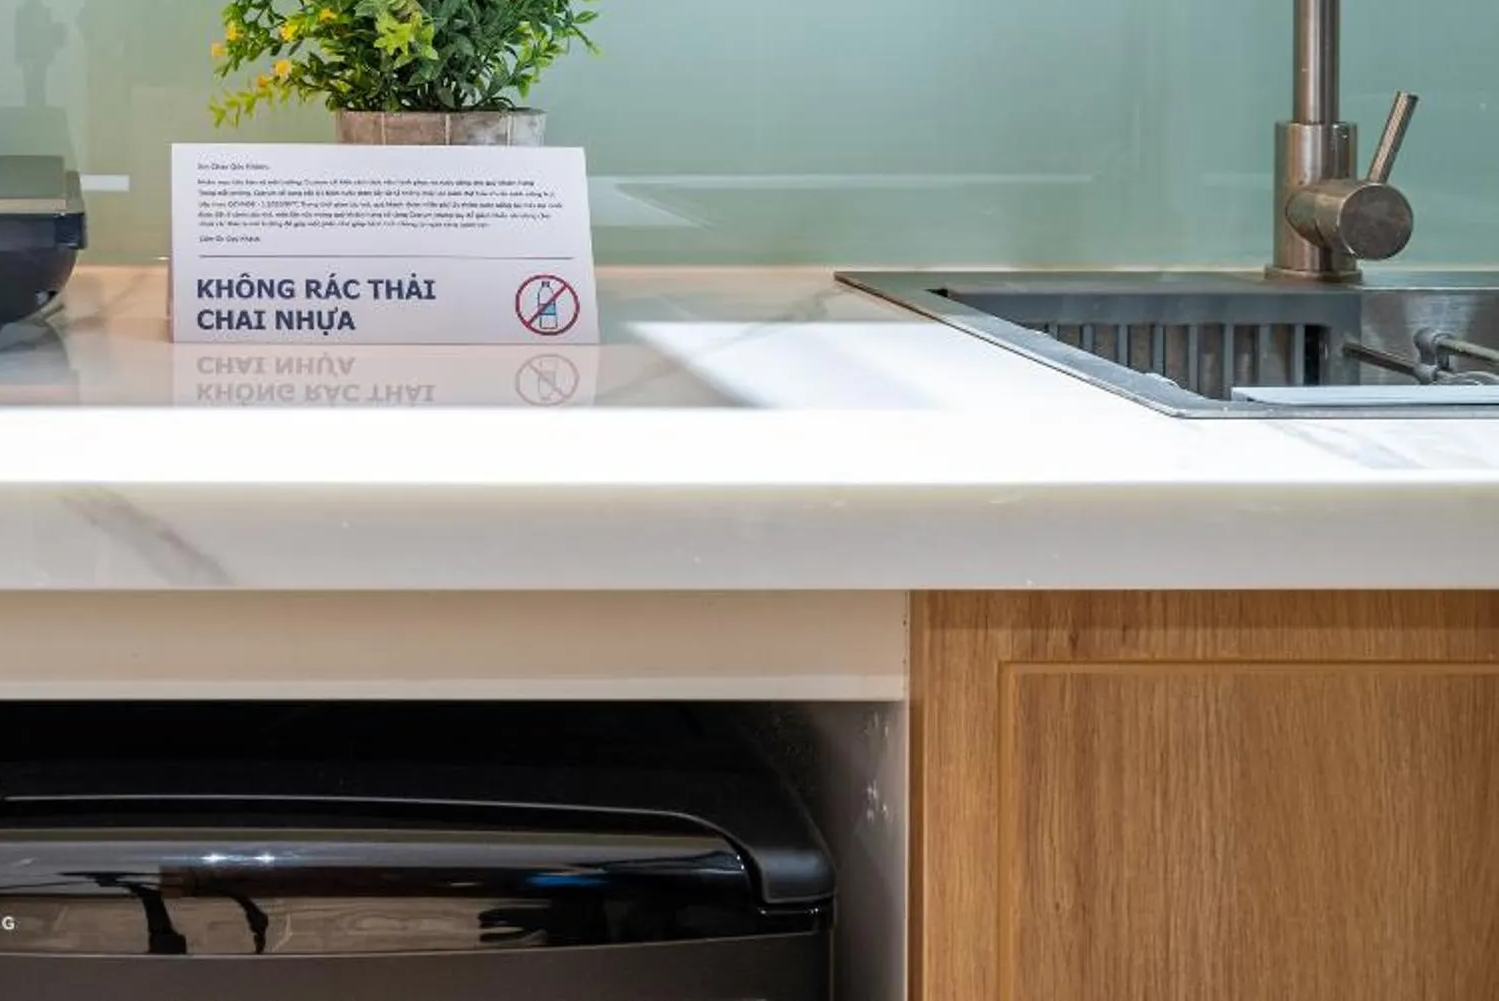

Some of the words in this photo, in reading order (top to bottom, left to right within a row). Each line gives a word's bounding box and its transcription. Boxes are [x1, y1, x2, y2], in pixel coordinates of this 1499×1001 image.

[197, 274, 296, 299] KHÔNG
[305, 273, 361, 300] RÁC
[367, 273, 436, 300] THẢI
[197, 309, 266, 331] CHAI
[275, 307, 356, 336] NHỰA
